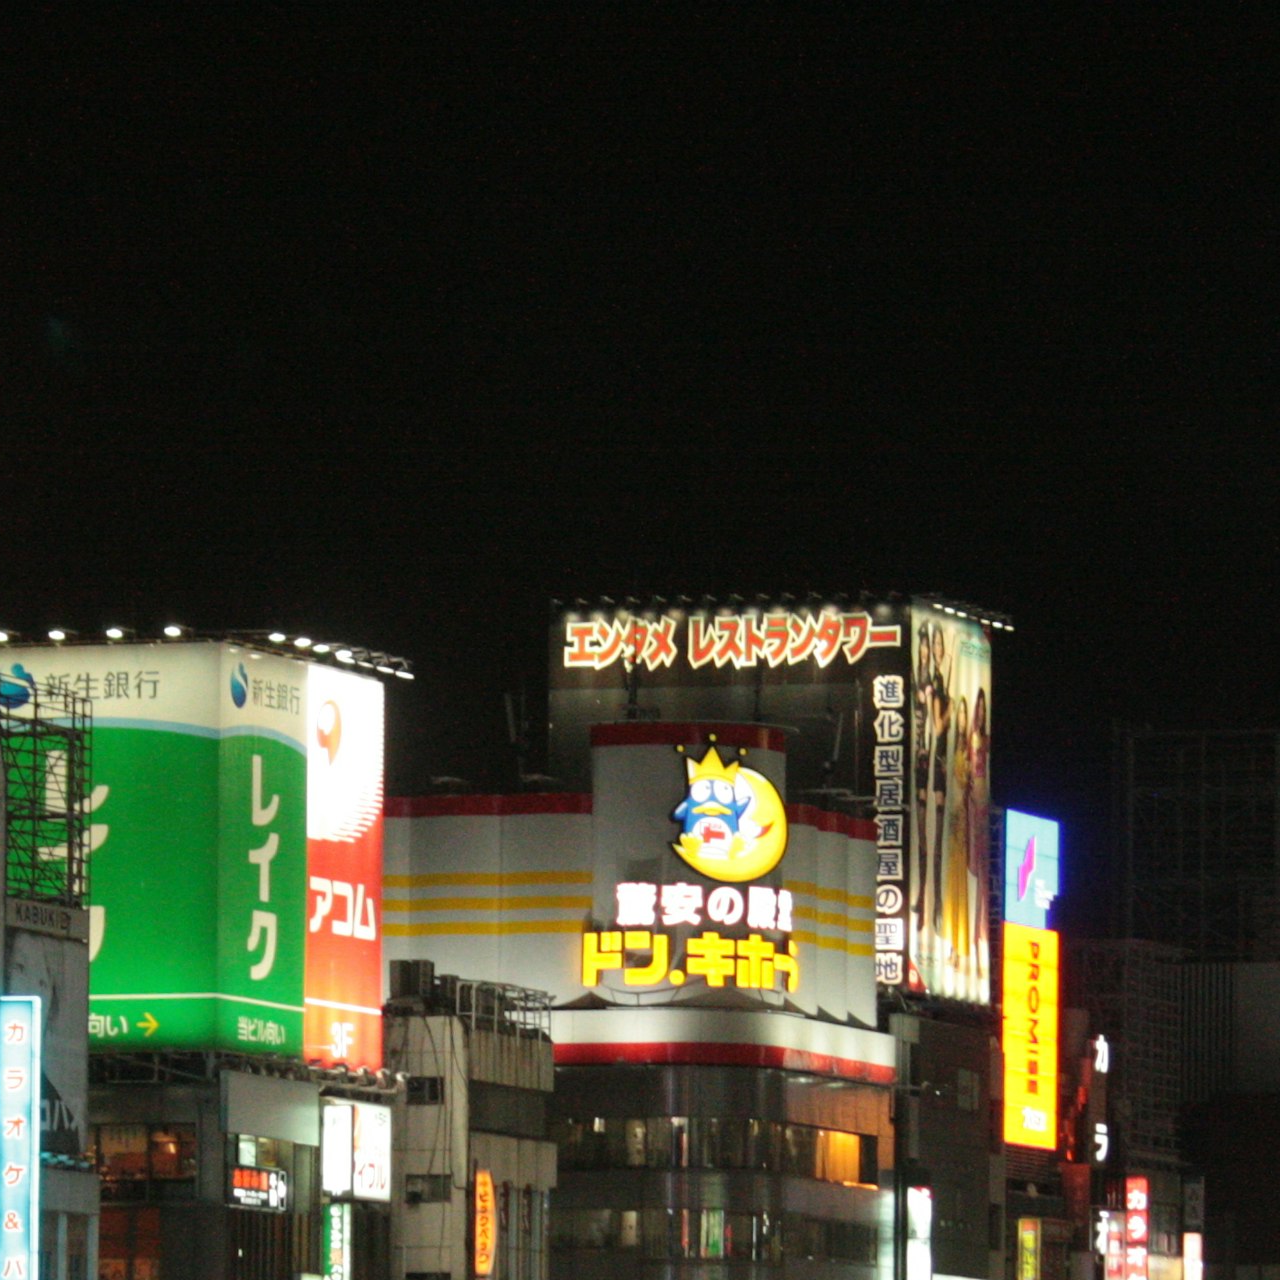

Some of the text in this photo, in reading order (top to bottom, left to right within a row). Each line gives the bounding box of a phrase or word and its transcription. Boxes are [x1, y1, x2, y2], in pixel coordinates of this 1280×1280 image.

[44, 670, 160, 701] 新生銀行
[251, 678, 301, 716] 新生銀行
[874, 674, 906, 986] 進化型居酒屋の聖地
[246, 754, 280, 981] レイク
[308, 873, 378, 941] アコム
[329, 1022, 354, 1058] 3F
[1026, 940, 1041, 1096] PROMISE
